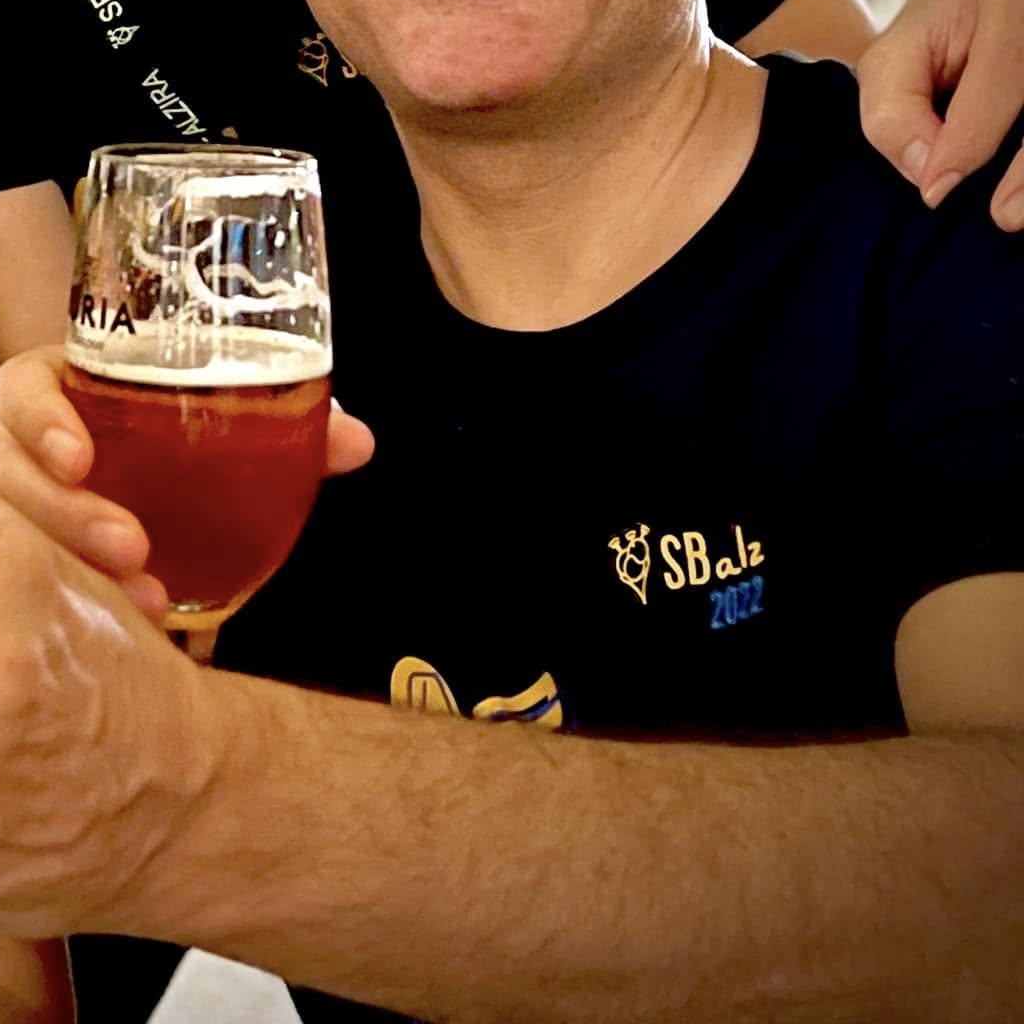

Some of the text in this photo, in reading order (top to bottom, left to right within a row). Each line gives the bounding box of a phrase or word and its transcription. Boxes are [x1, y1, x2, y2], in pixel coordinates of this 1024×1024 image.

[141, 67, 208, 136] ALZIRA
[660, 524, 766, 591] SBalz
[710, 575, 765, 630] 2022
